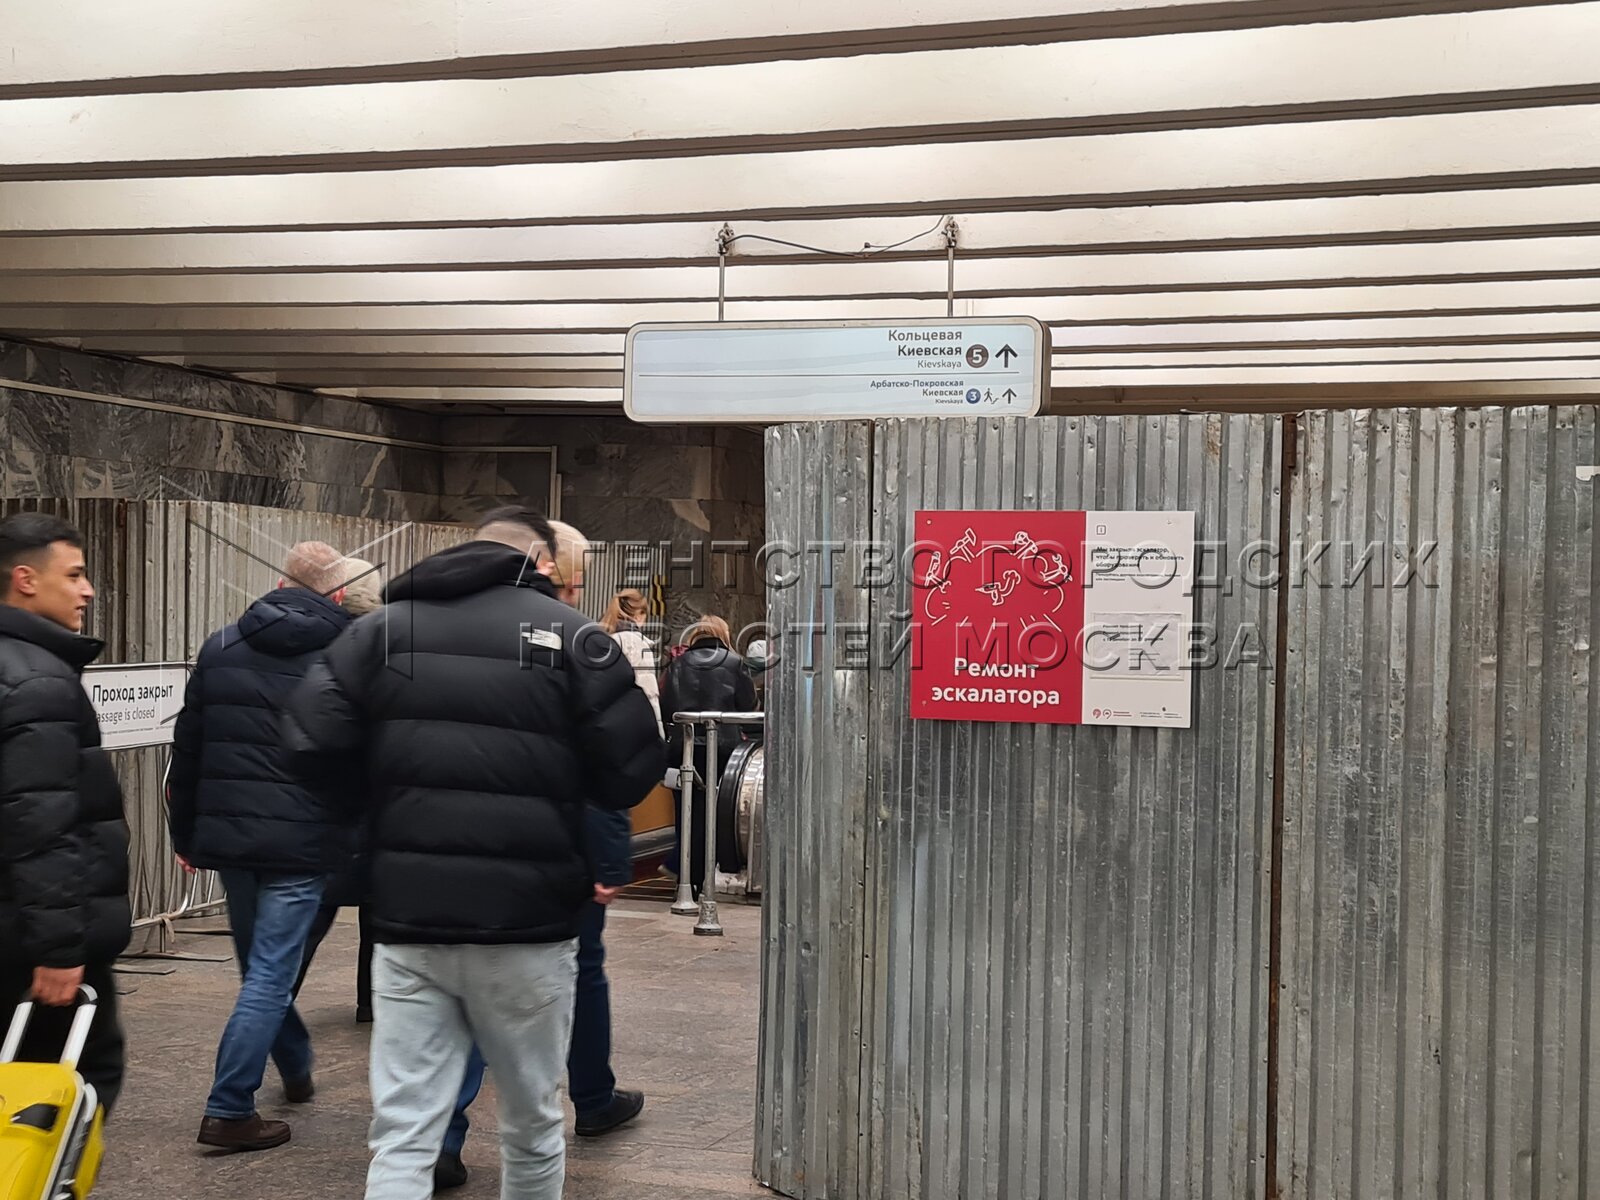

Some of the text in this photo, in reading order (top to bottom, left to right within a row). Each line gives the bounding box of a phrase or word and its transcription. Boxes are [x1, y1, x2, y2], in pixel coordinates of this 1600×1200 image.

[888, 330, 962, 342] Кольцевая
[898, 345, 962, 356] Киевская
[917, 359, 962, 369] Kievskaya
[870, 380, 964, 389] Арбатско-Покровская
[922, 389, 964, 397] Киевская
[954, 657, 1039, 679] Ремонт
[92, 685, 174, 706] Проход закрыт
[931, 687, 1060, 709] эскалатора
[97, 706, 155, 725] assage is closed
